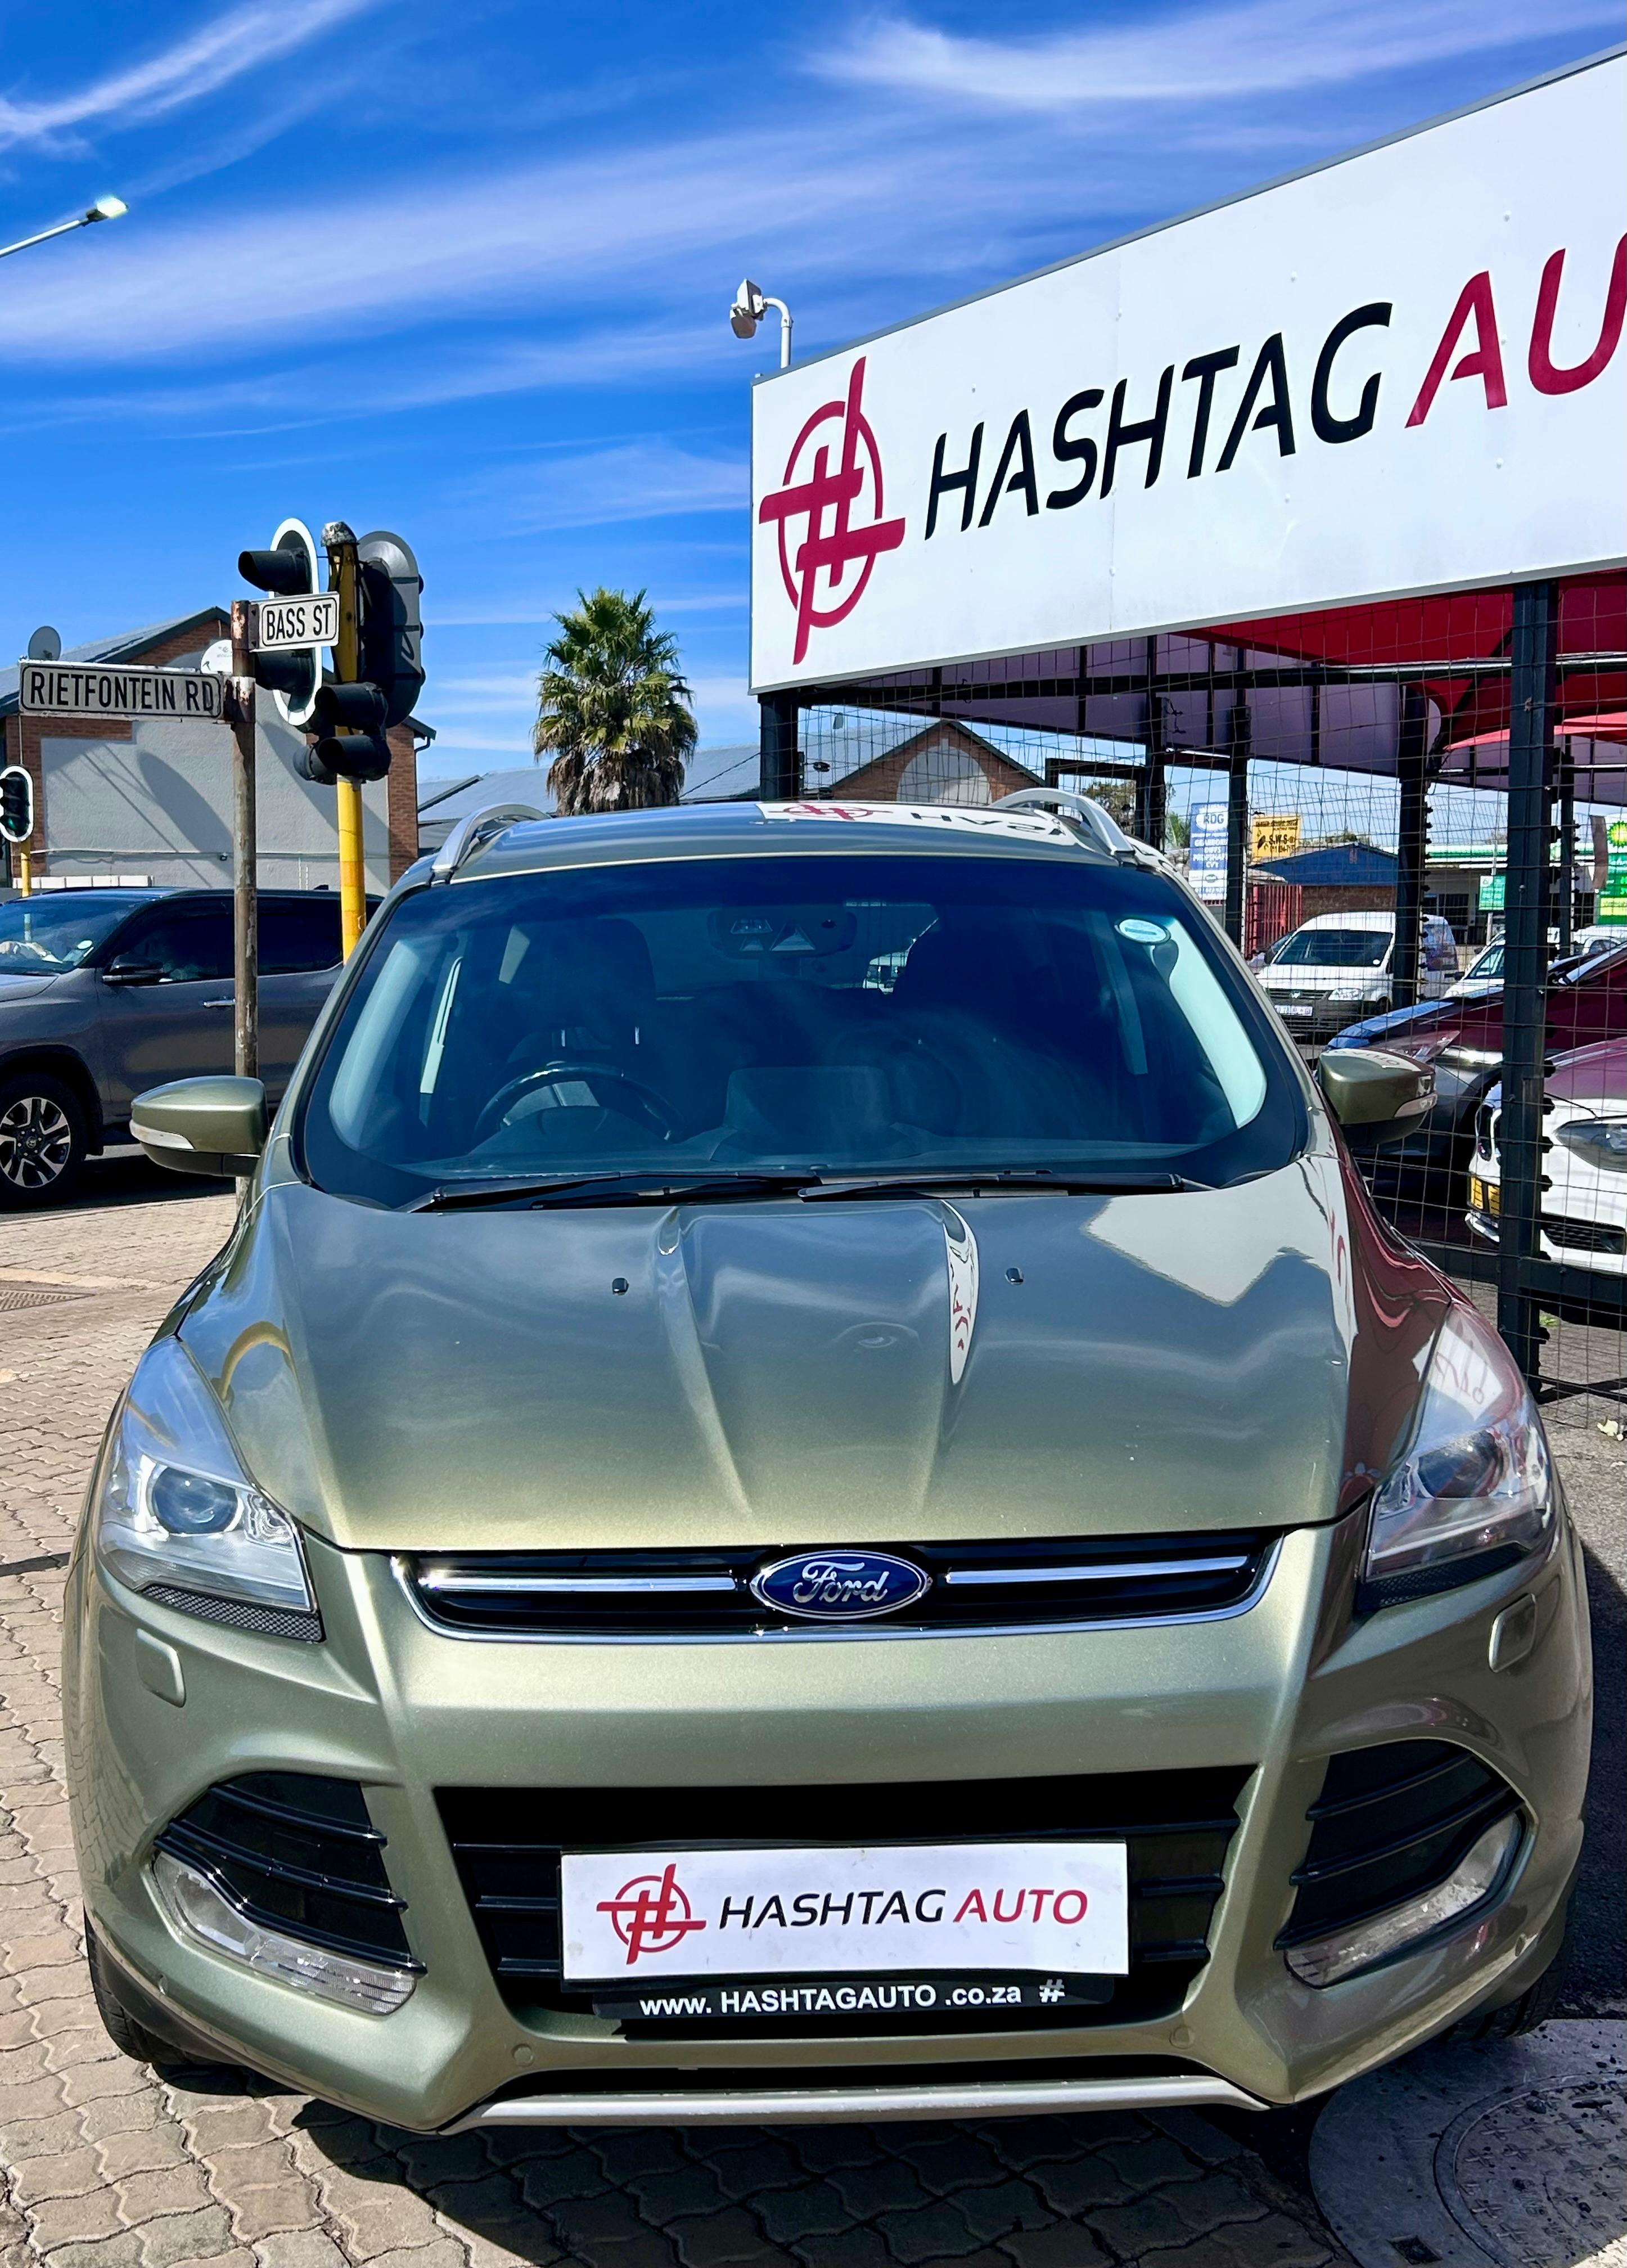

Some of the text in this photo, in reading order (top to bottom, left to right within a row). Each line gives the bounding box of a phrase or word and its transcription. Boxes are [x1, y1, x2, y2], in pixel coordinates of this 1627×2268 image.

[925, 302, 1393, 541] HASHTAG
[267, 604, 332, 641] BASS ST
[30, 671, 215, 713] RIETFONTEIN RD
[793, 1562, 890, 1603] Ford
[719, 1889, 1088, 1929] HASHTAG AUTO
[639, 1997, 712, 2015] www.
[721, 1984, 936, 2013] HASHTAGAUTO
[945, 1986, 1022, 2005] .co.za
